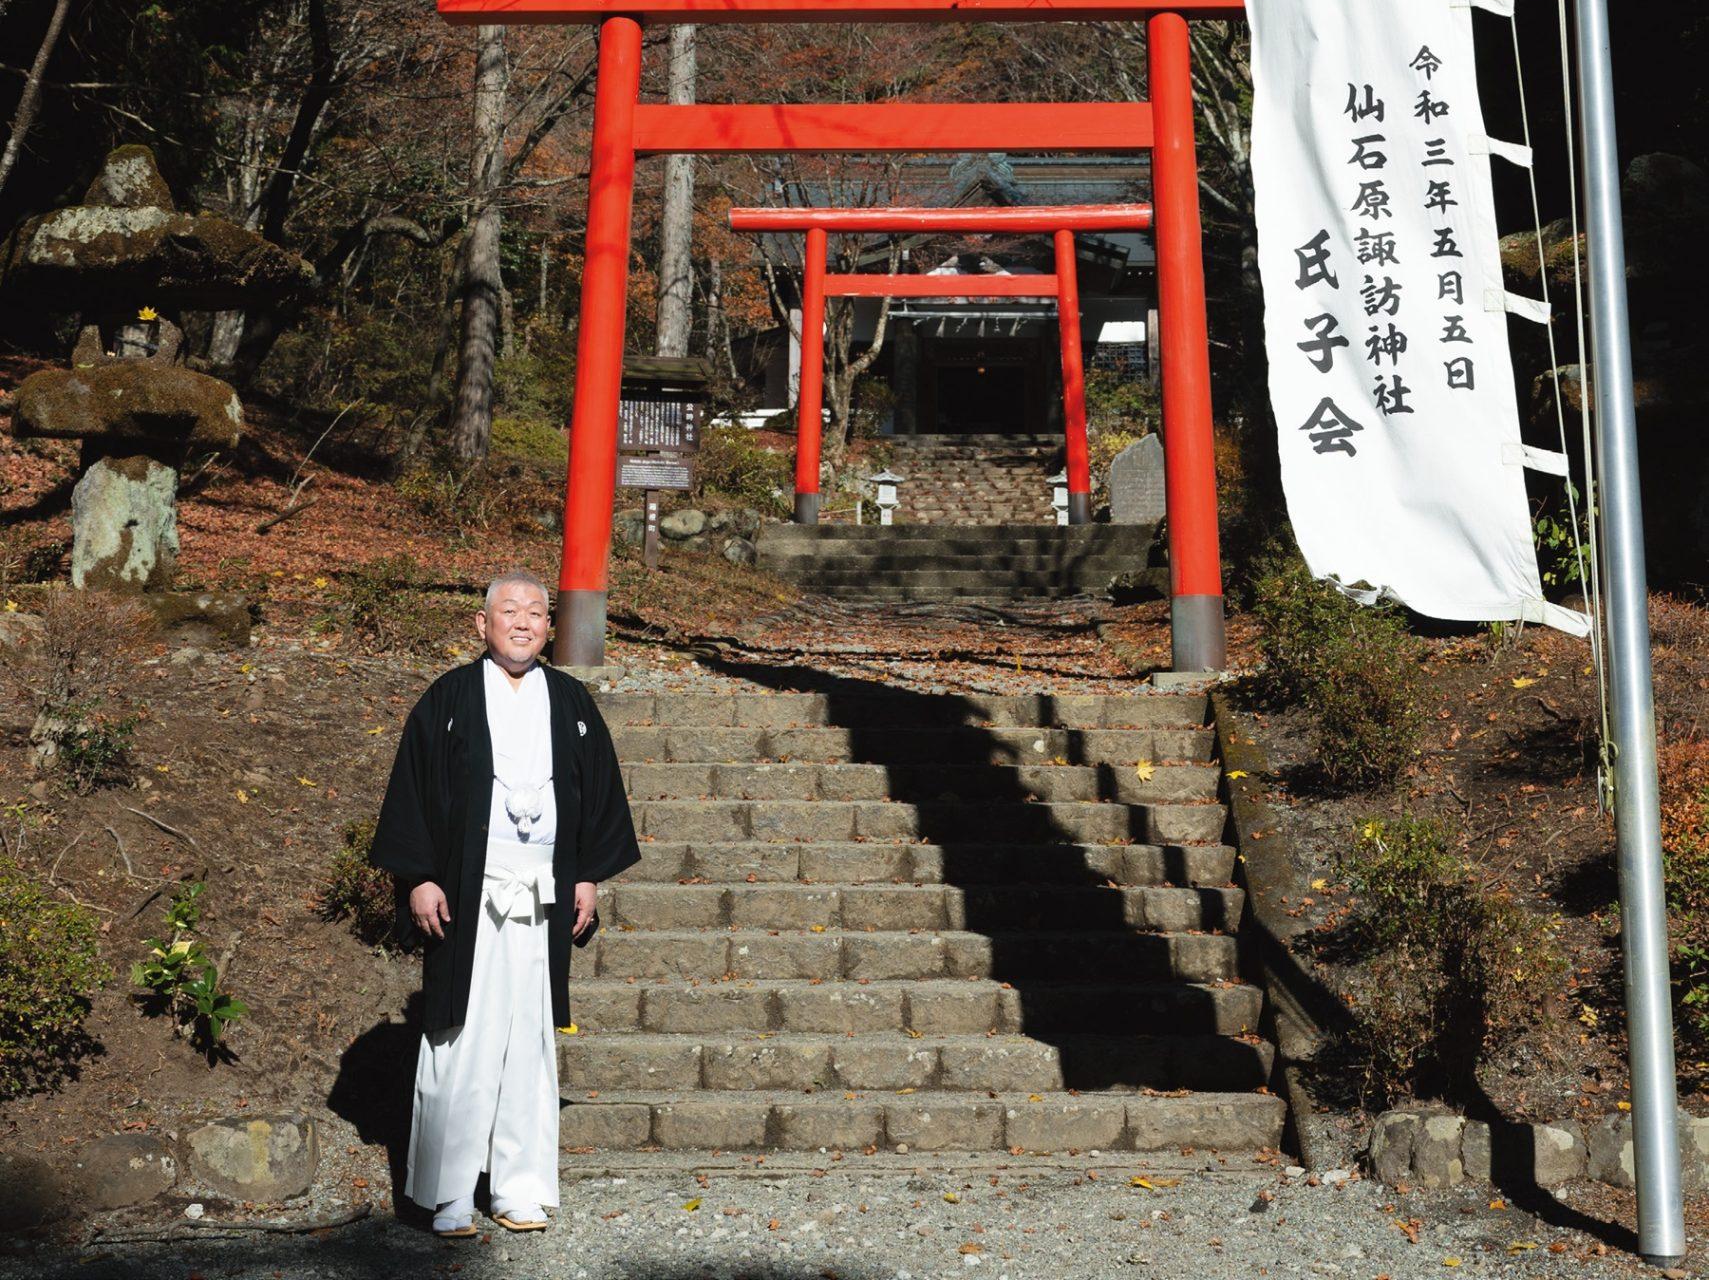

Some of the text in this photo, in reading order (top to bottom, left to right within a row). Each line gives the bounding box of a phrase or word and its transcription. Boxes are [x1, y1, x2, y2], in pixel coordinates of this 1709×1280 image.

[1293, 229, 1365, 458] 氏子会
[1343, 82, 1415, 417] 仙石原諏訪神社
[1408, 45, 1475, 391] 令和三年五月五日
